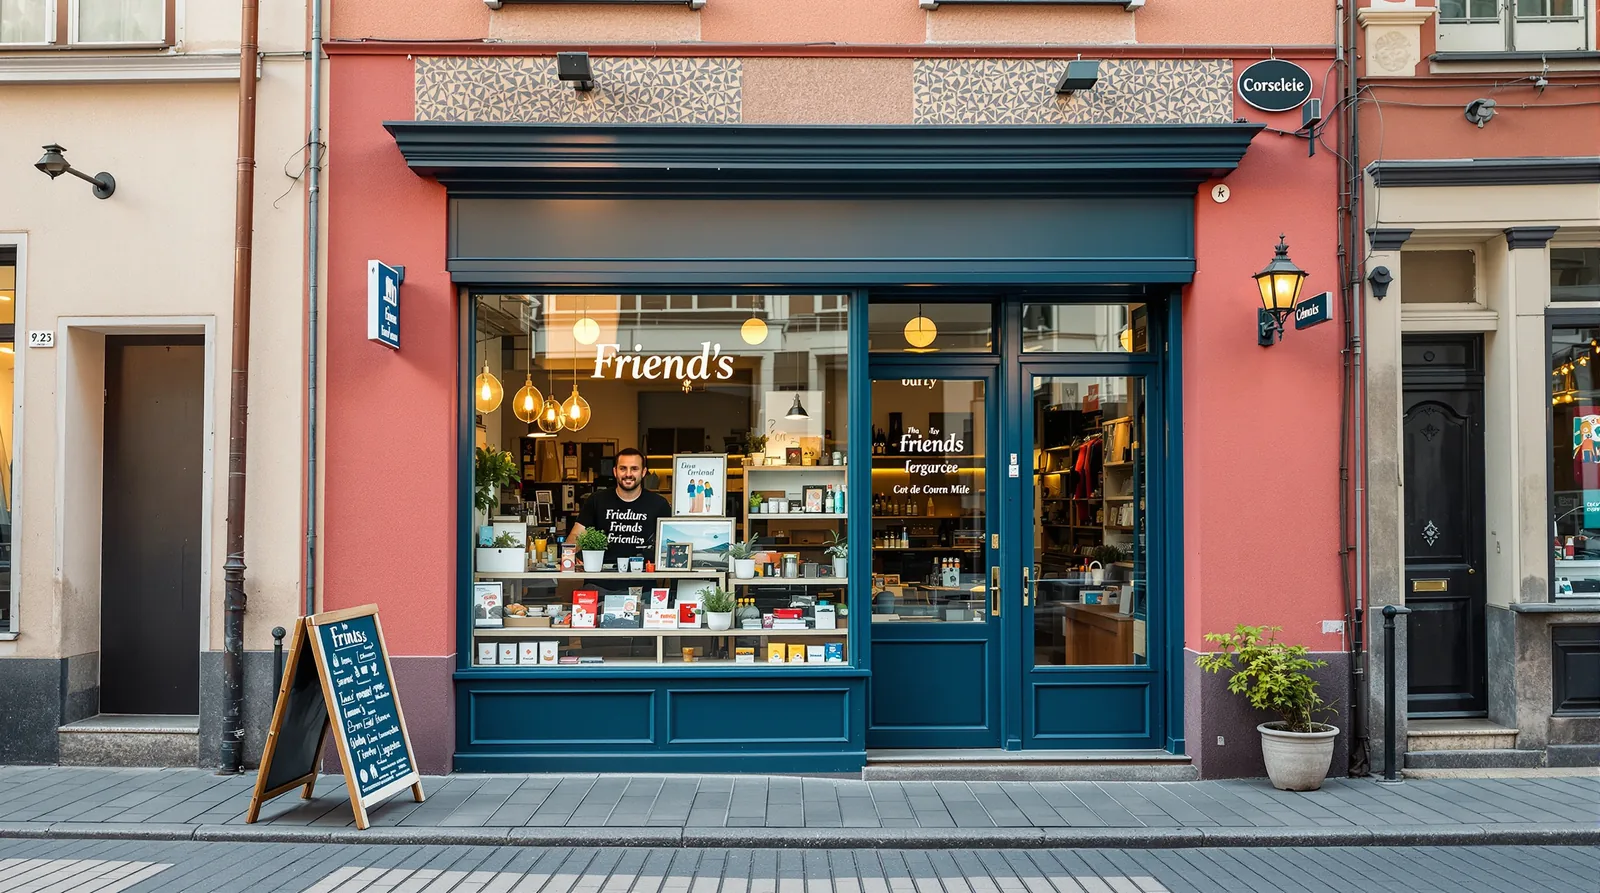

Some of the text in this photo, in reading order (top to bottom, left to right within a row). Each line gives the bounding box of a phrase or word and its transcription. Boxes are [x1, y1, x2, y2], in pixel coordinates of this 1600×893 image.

[591, 341, 734, 380] Friend's
[909, 484, 921, 494] de
[609, 521, 643, 533] Friends
